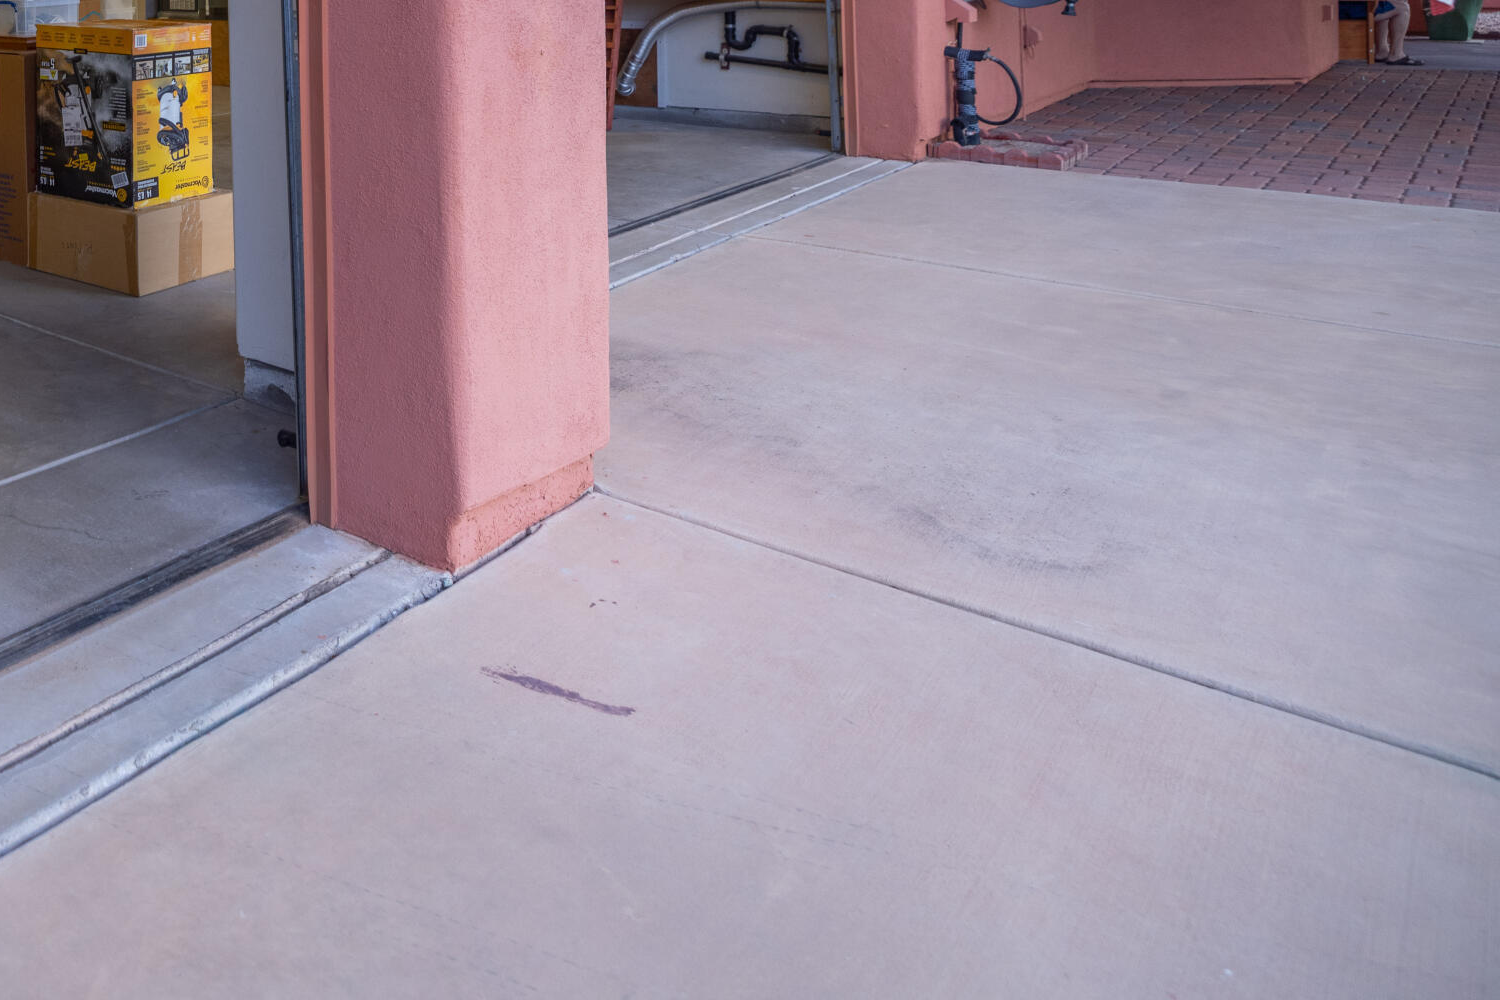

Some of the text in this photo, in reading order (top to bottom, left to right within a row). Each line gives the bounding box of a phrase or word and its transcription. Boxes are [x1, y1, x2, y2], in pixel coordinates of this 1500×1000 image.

[64, 157, 97, 172] BEAST
[160, 160, 186, 174] BEAST
[174, 179, 202, 190] Vacmaster
[85, 185, 118, 198] Vacmaster
